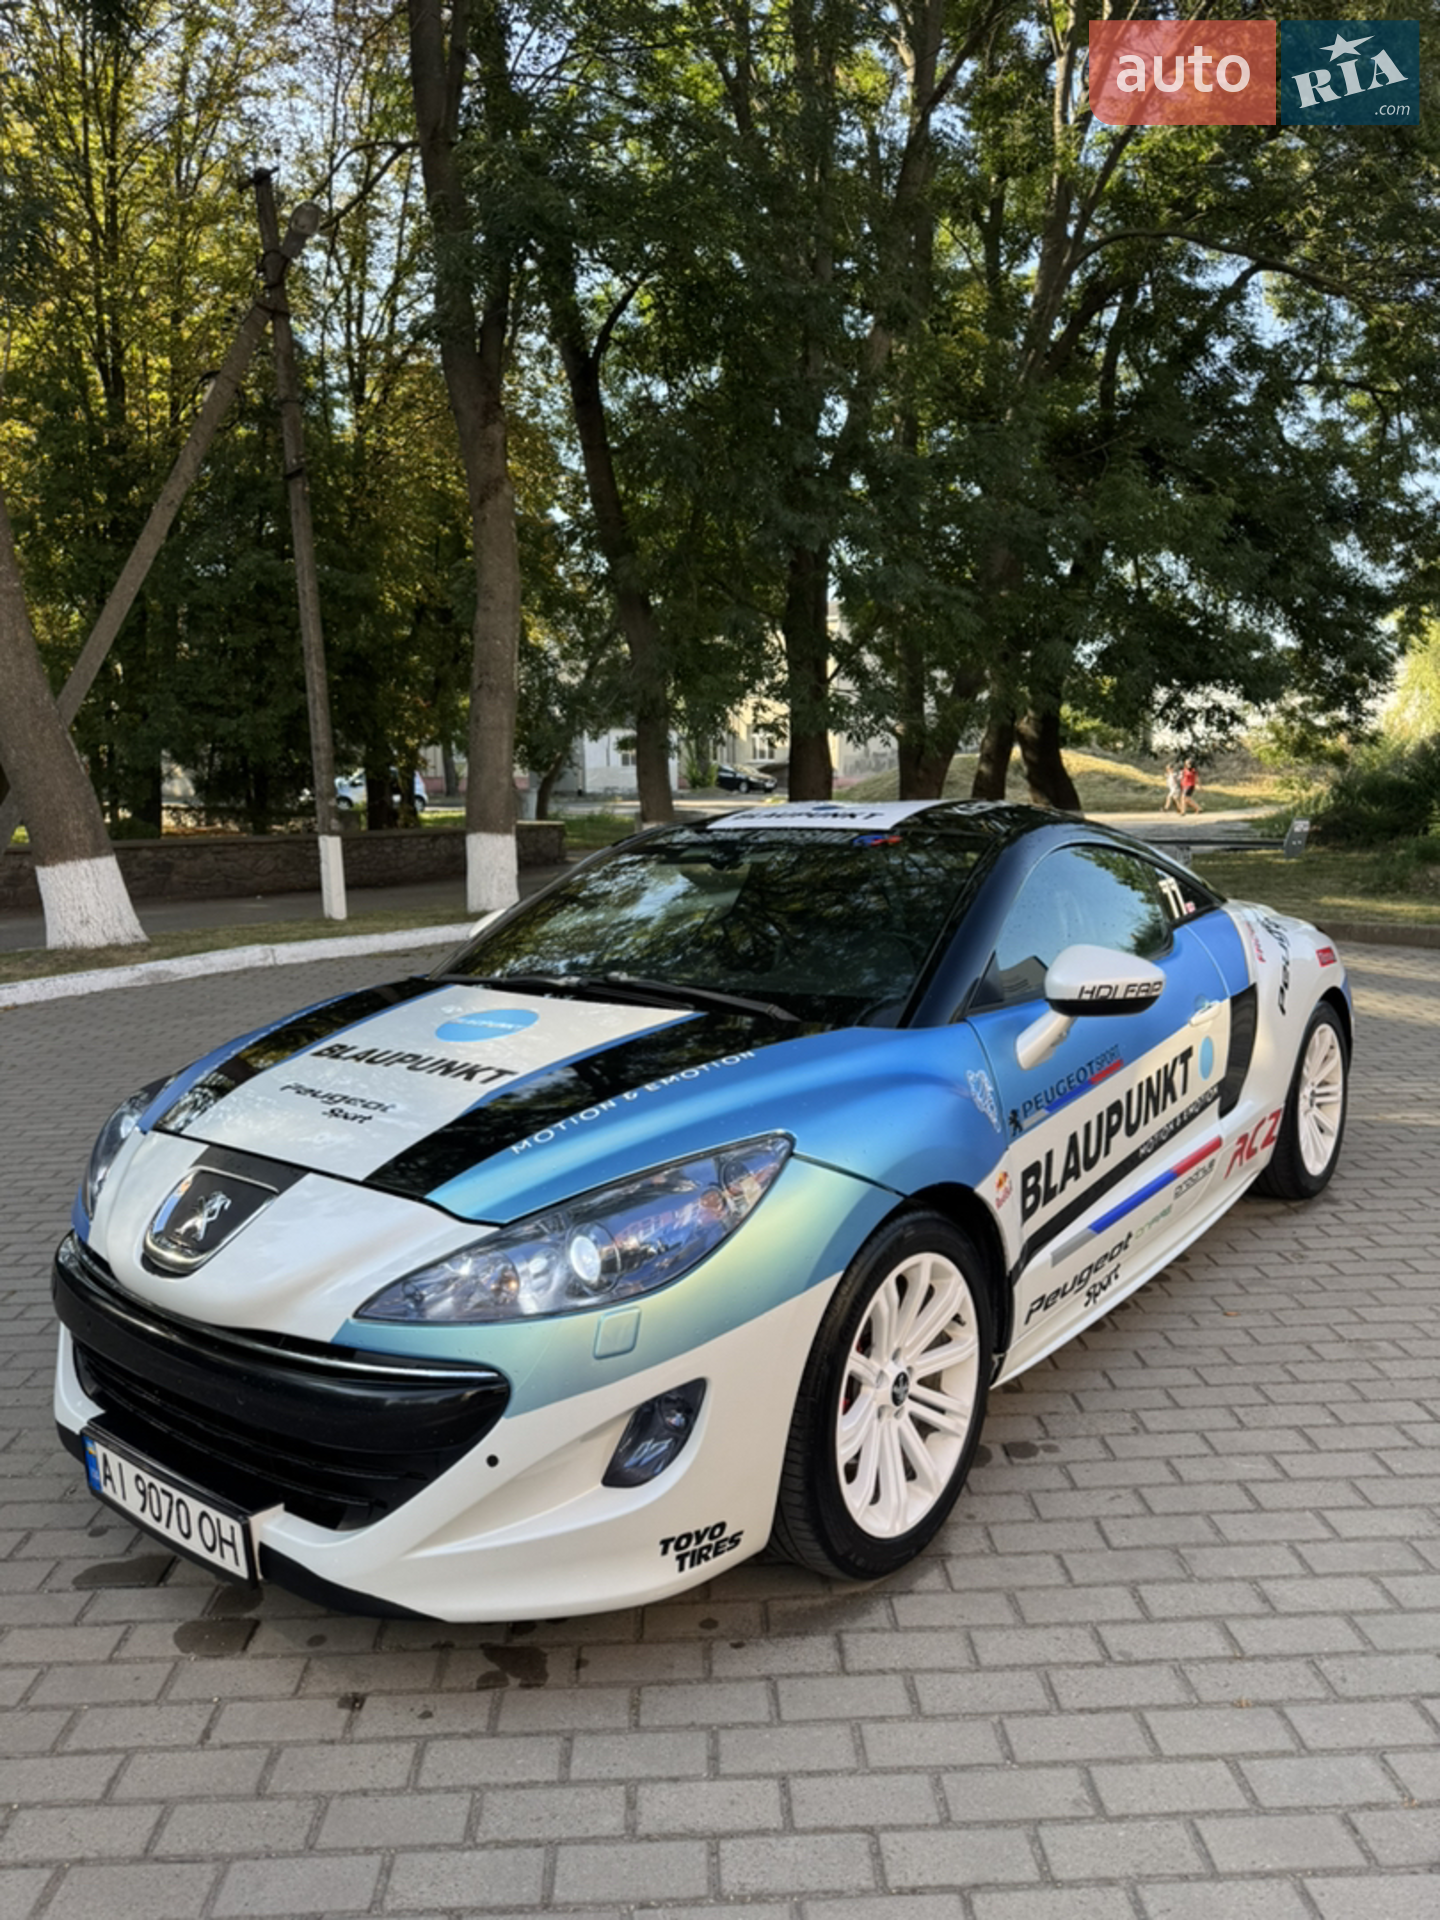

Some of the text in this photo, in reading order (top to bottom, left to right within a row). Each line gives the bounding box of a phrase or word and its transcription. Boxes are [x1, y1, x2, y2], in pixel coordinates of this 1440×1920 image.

[311, 1043, 518, 1084] BLAUPUNKT
[1022, 1060, 1096, 1118] PEUGEOT
[511, 1051, 756, 1154] MOTION & EMOTION
[1021, 1046, 1193, 1226] BLAUPUNKT
[1024, 1231, 1132, 1325] Peugeot
[103, 1452, 240, 1567] AI 9070 OH
[659, 1520, 727, 1556] TOYO
[675, 1530, 744, 1573] TIRES
